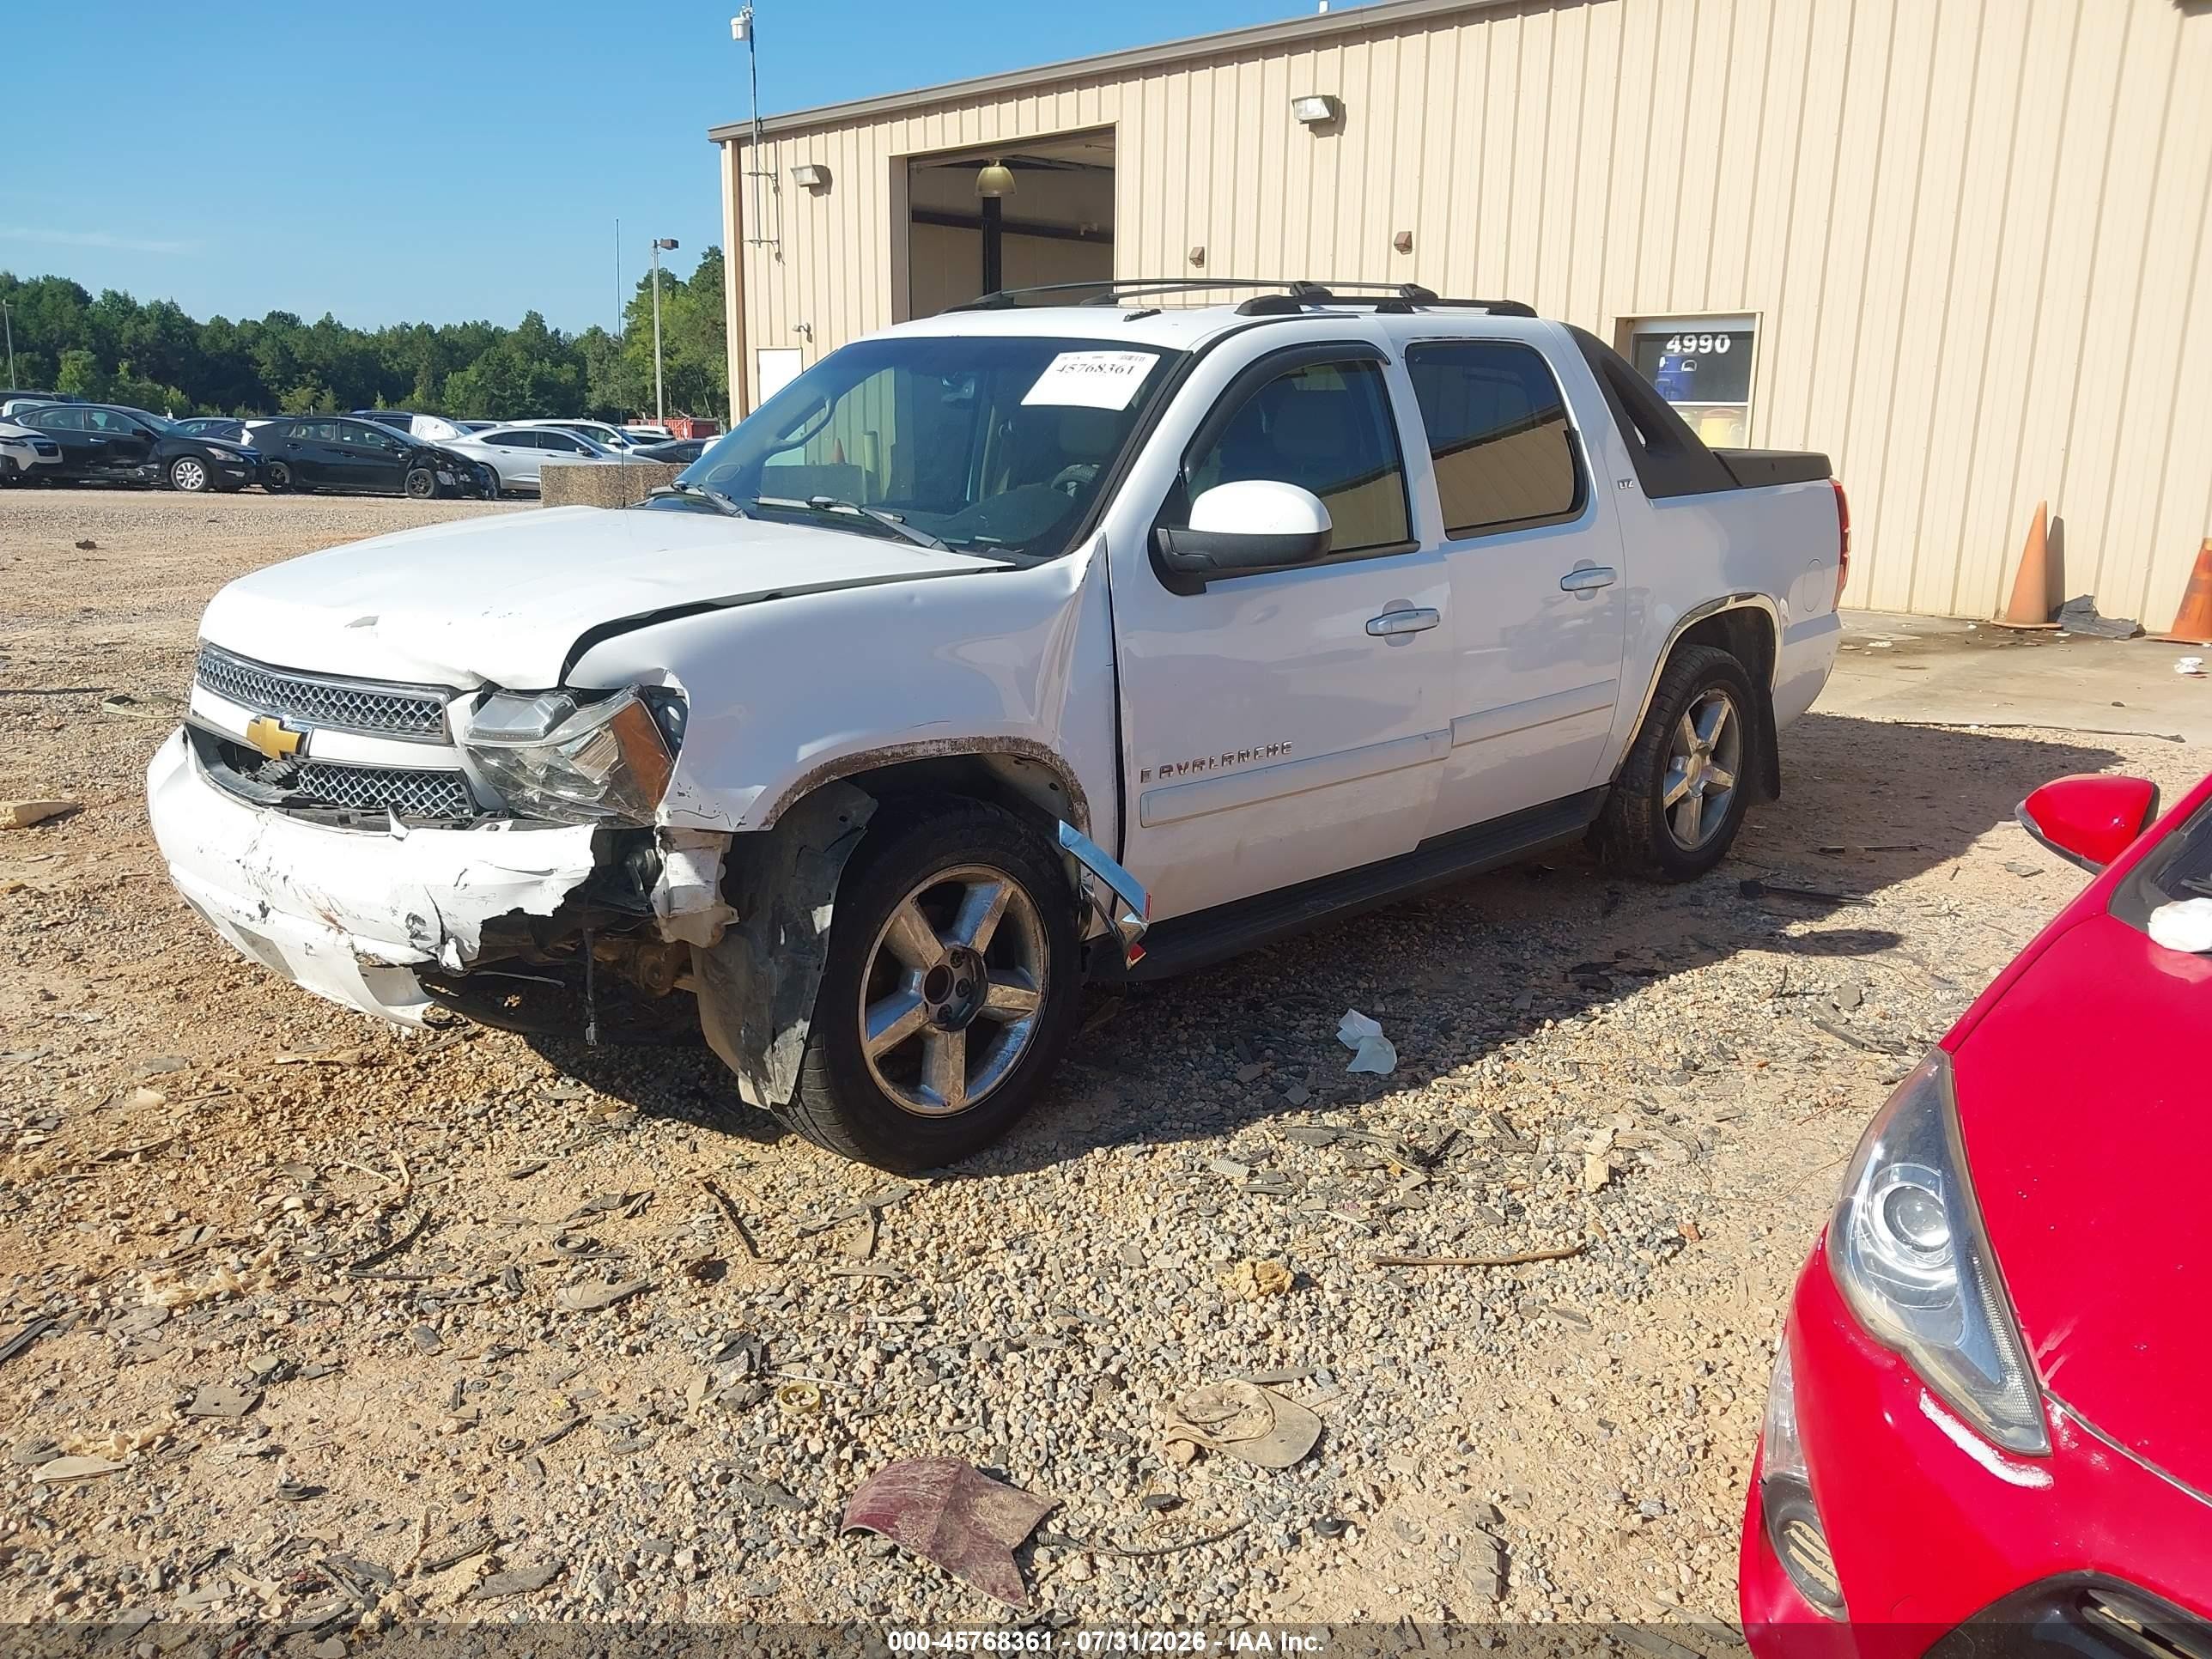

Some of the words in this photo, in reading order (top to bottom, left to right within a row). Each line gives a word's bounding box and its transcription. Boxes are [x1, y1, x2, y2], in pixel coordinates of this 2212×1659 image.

[1666, 334, 1731, 354] 4990
[1056, 362, 1135, 375] 45768361
[1159, 740, 1293, 779] AVALANCHE
